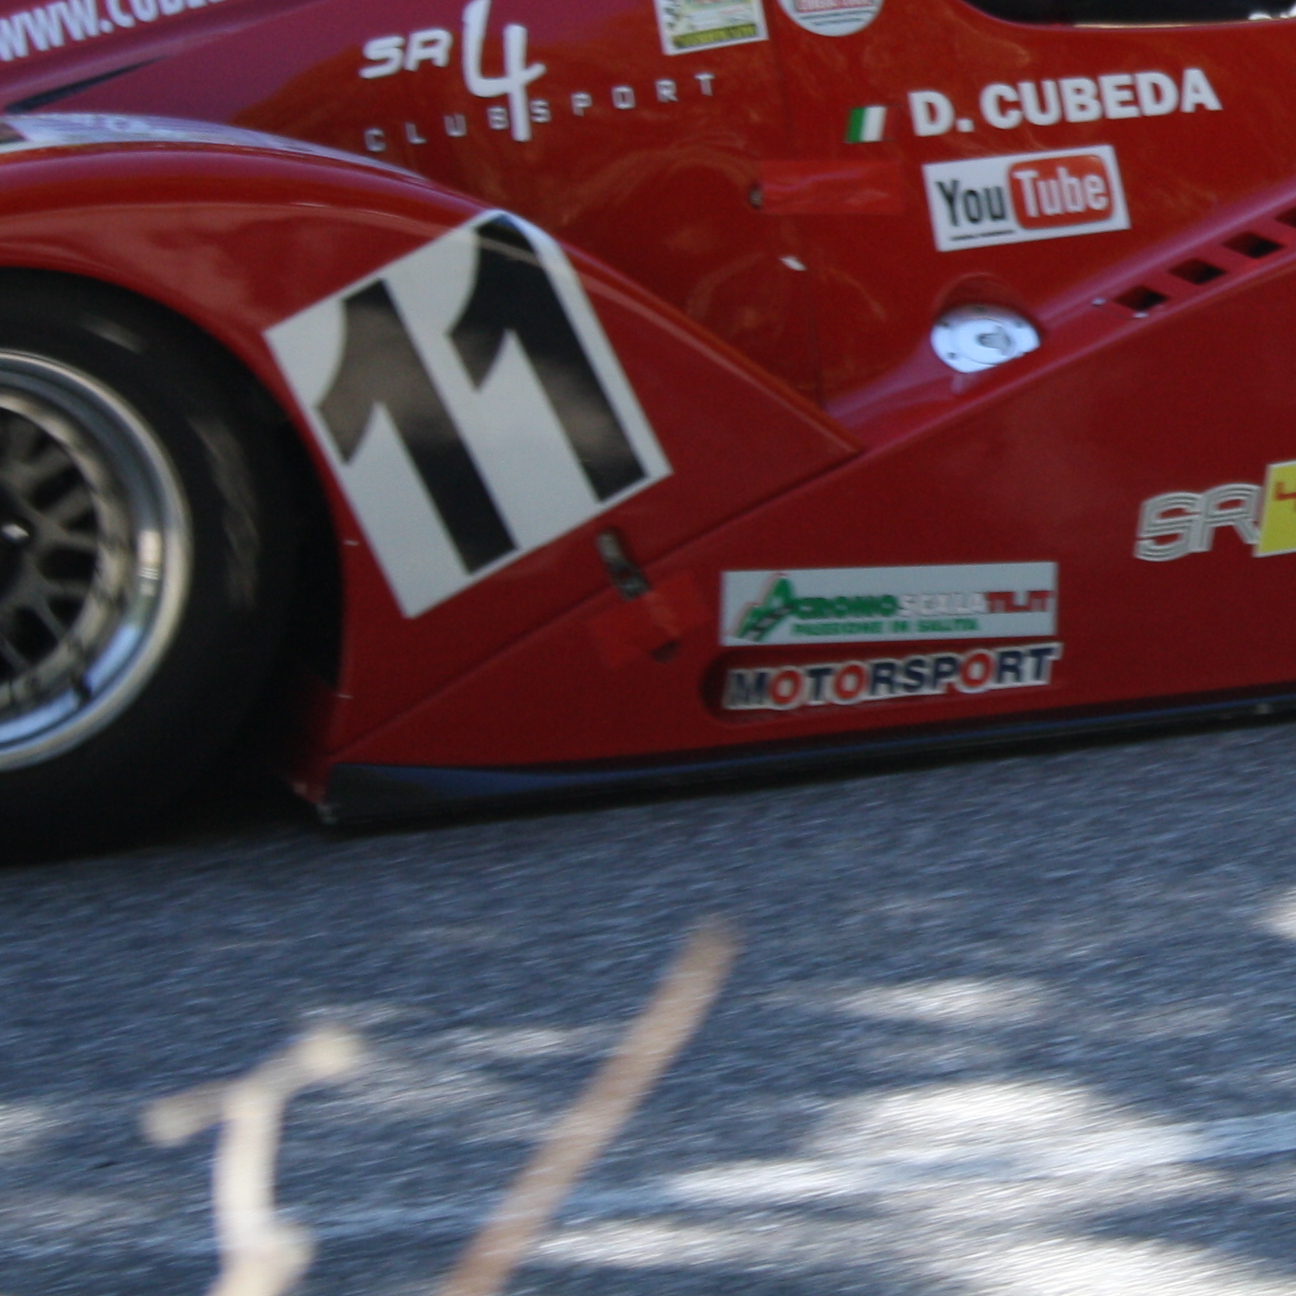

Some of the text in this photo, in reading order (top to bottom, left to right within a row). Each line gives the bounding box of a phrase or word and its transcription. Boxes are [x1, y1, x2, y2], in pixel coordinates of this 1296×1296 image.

[908, 68, 1222, 137] D. CUBEDA
[312, 213, 648, 576] 11
[726, 644, 1057, 707] MOTORSPORT
